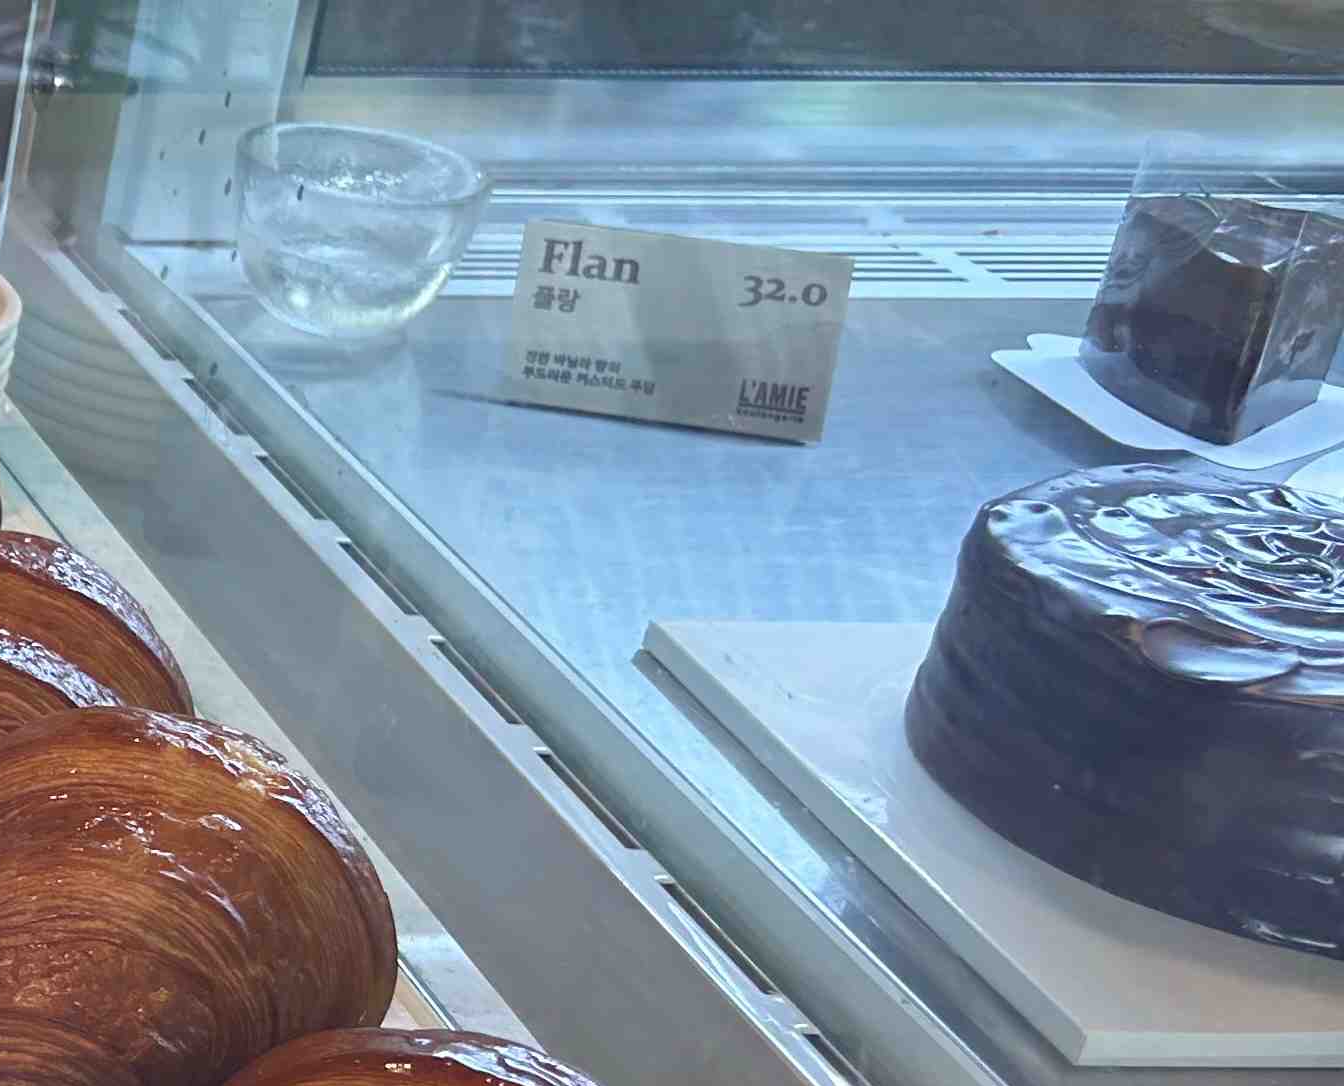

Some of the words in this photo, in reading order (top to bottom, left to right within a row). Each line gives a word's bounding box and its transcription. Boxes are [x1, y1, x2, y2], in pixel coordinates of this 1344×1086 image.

[538, 238, 640, 285] Flan
[532, 285, 581, 313] 플랑
[737, 274, 829, 307] 32.0
[738, 378, 811, 410] L'AMIE
